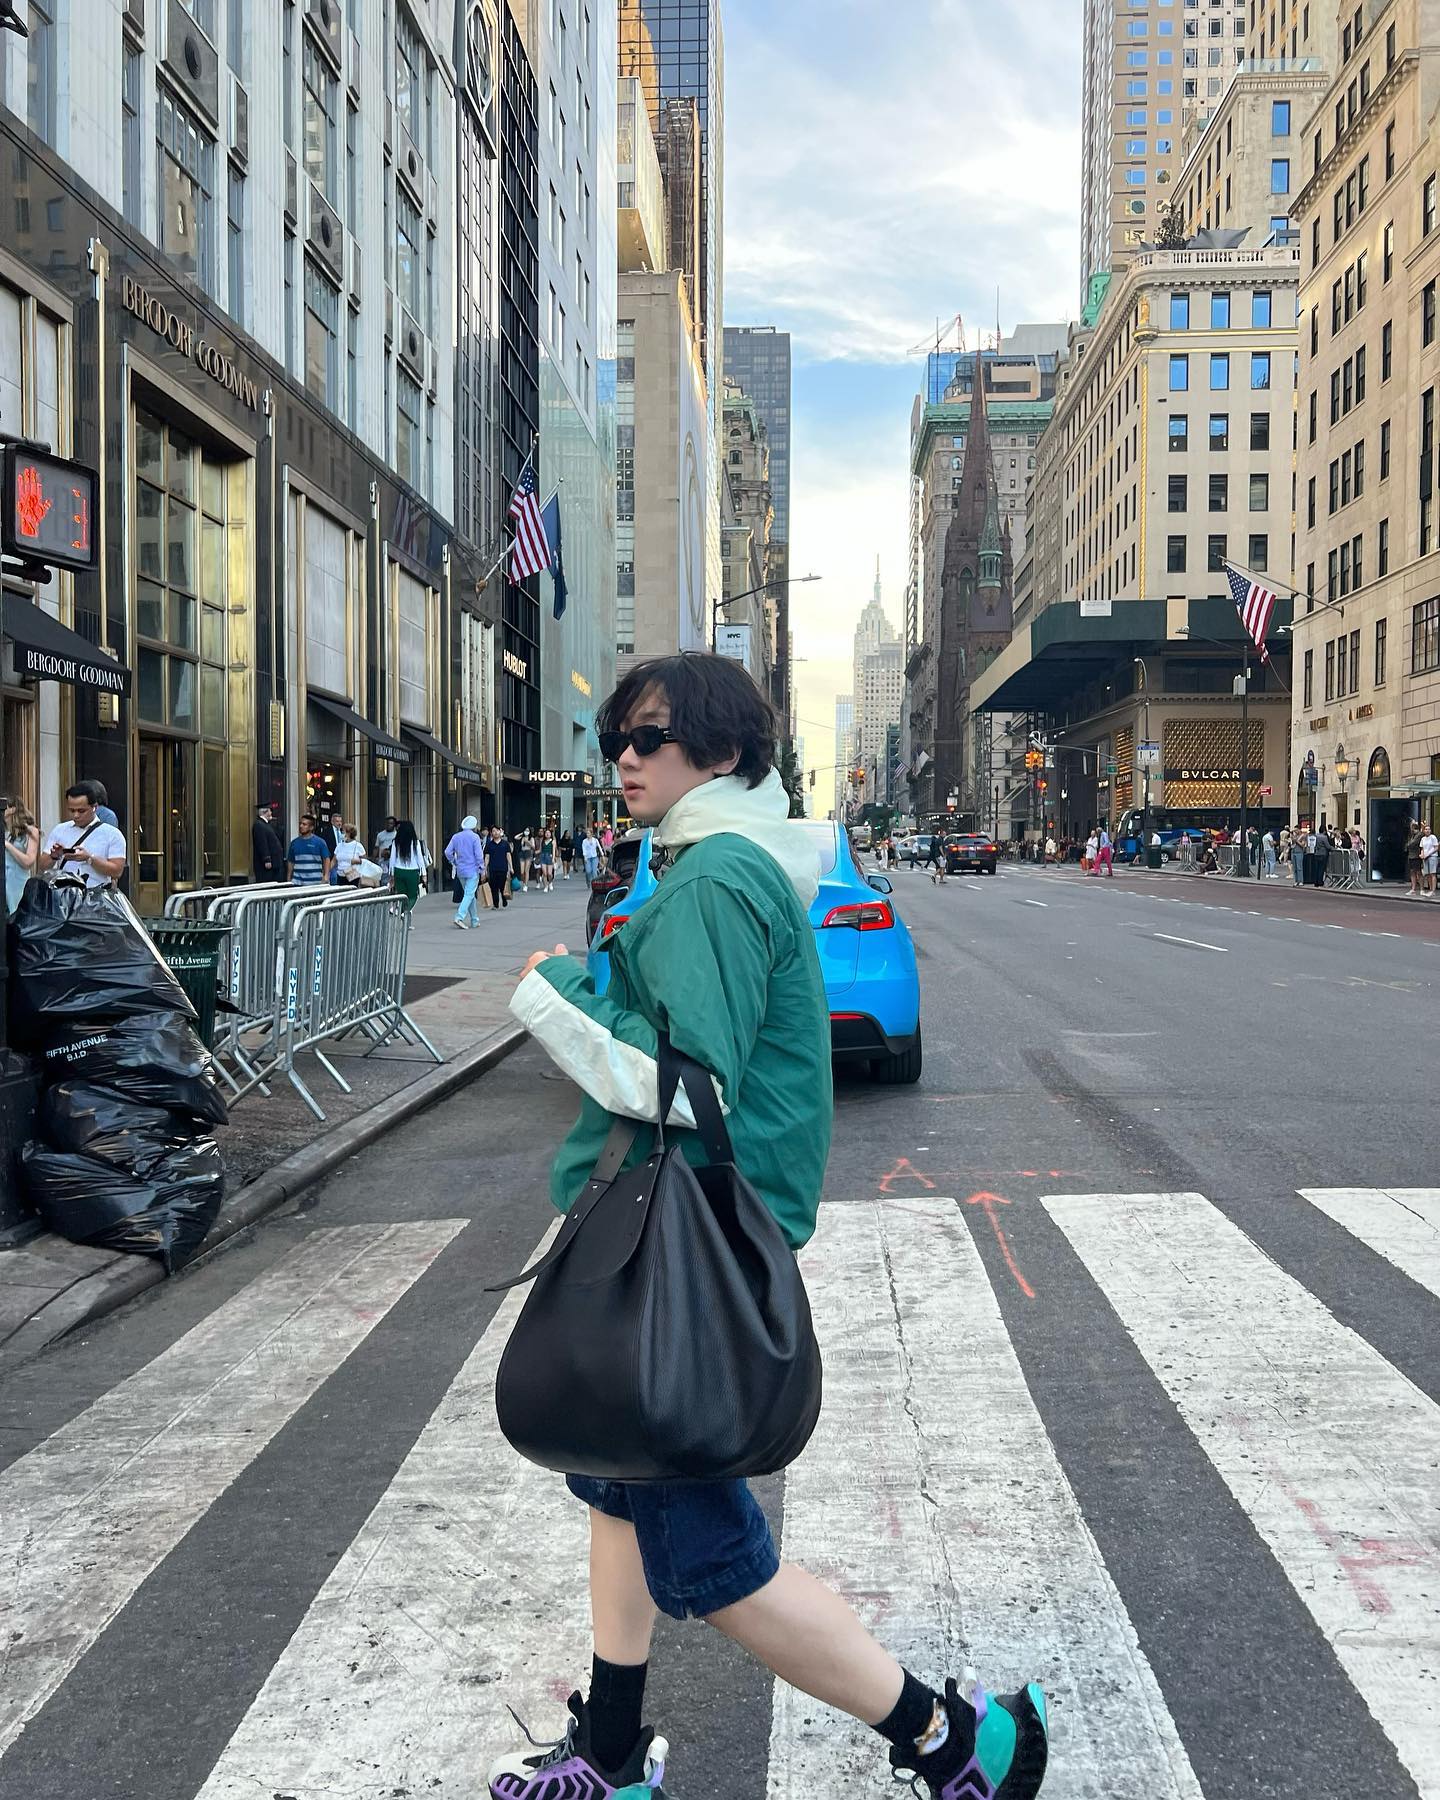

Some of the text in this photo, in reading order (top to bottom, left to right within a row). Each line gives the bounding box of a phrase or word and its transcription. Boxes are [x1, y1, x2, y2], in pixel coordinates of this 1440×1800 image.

[123, 275, 258, 412] BERGDORF GOODMAN
[27, 649, 124, 691] BERGDORF GOODMAN
[503, 648, 527, 680] HUBLOT
[528, 771, 577, 782] HUBLOT
[1181, 770, 1240, 779] BVLGAR
[186, 956, 212, 965] Avenue
[232, 947, 240, 994] NYPD
[314, 947, 323, 993] NYPD
[288, 969, 297, 1019] NYPD
[46, 1034, 109, 1059] FIFTH AVENUE
